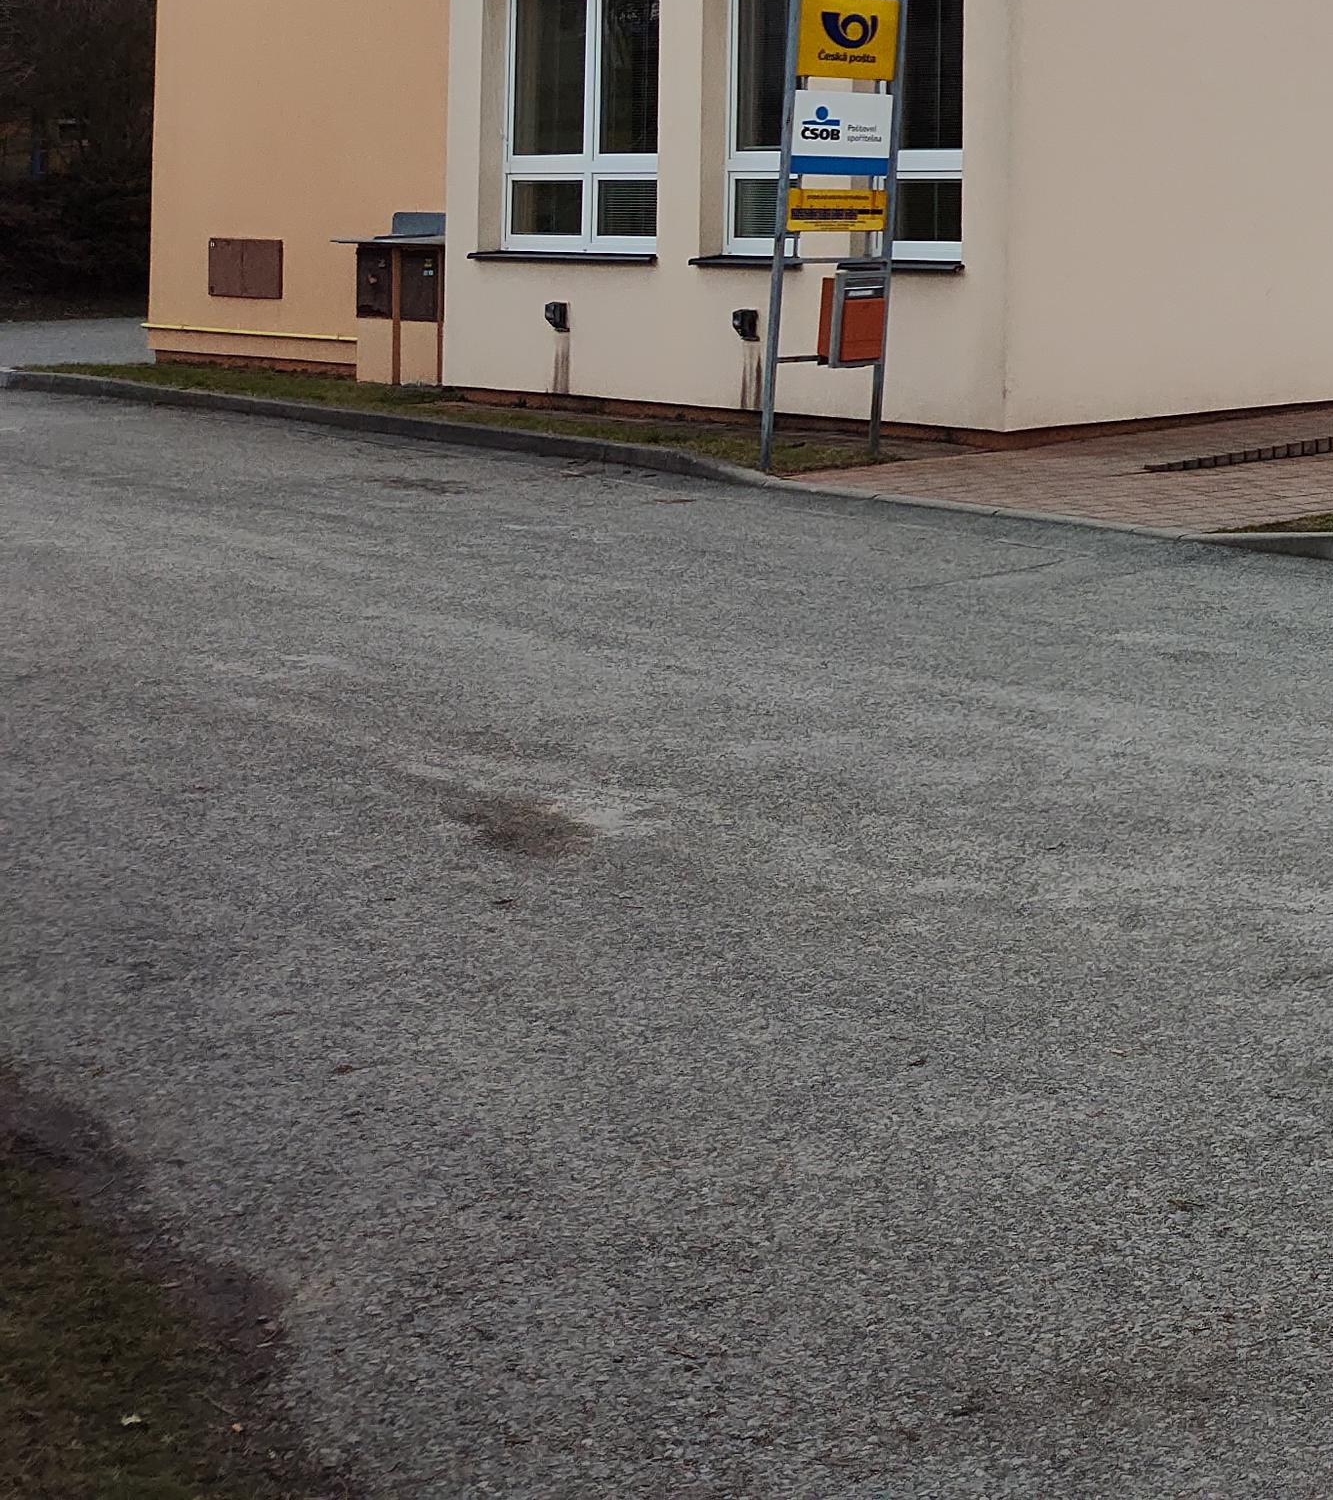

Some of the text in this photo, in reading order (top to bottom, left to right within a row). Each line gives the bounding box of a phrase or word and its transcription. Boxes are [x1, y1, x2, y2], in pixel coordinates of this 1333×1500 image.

[818, 49, 876, 64] Česká pošta
[801, 127, 840, 140] ČSOB
